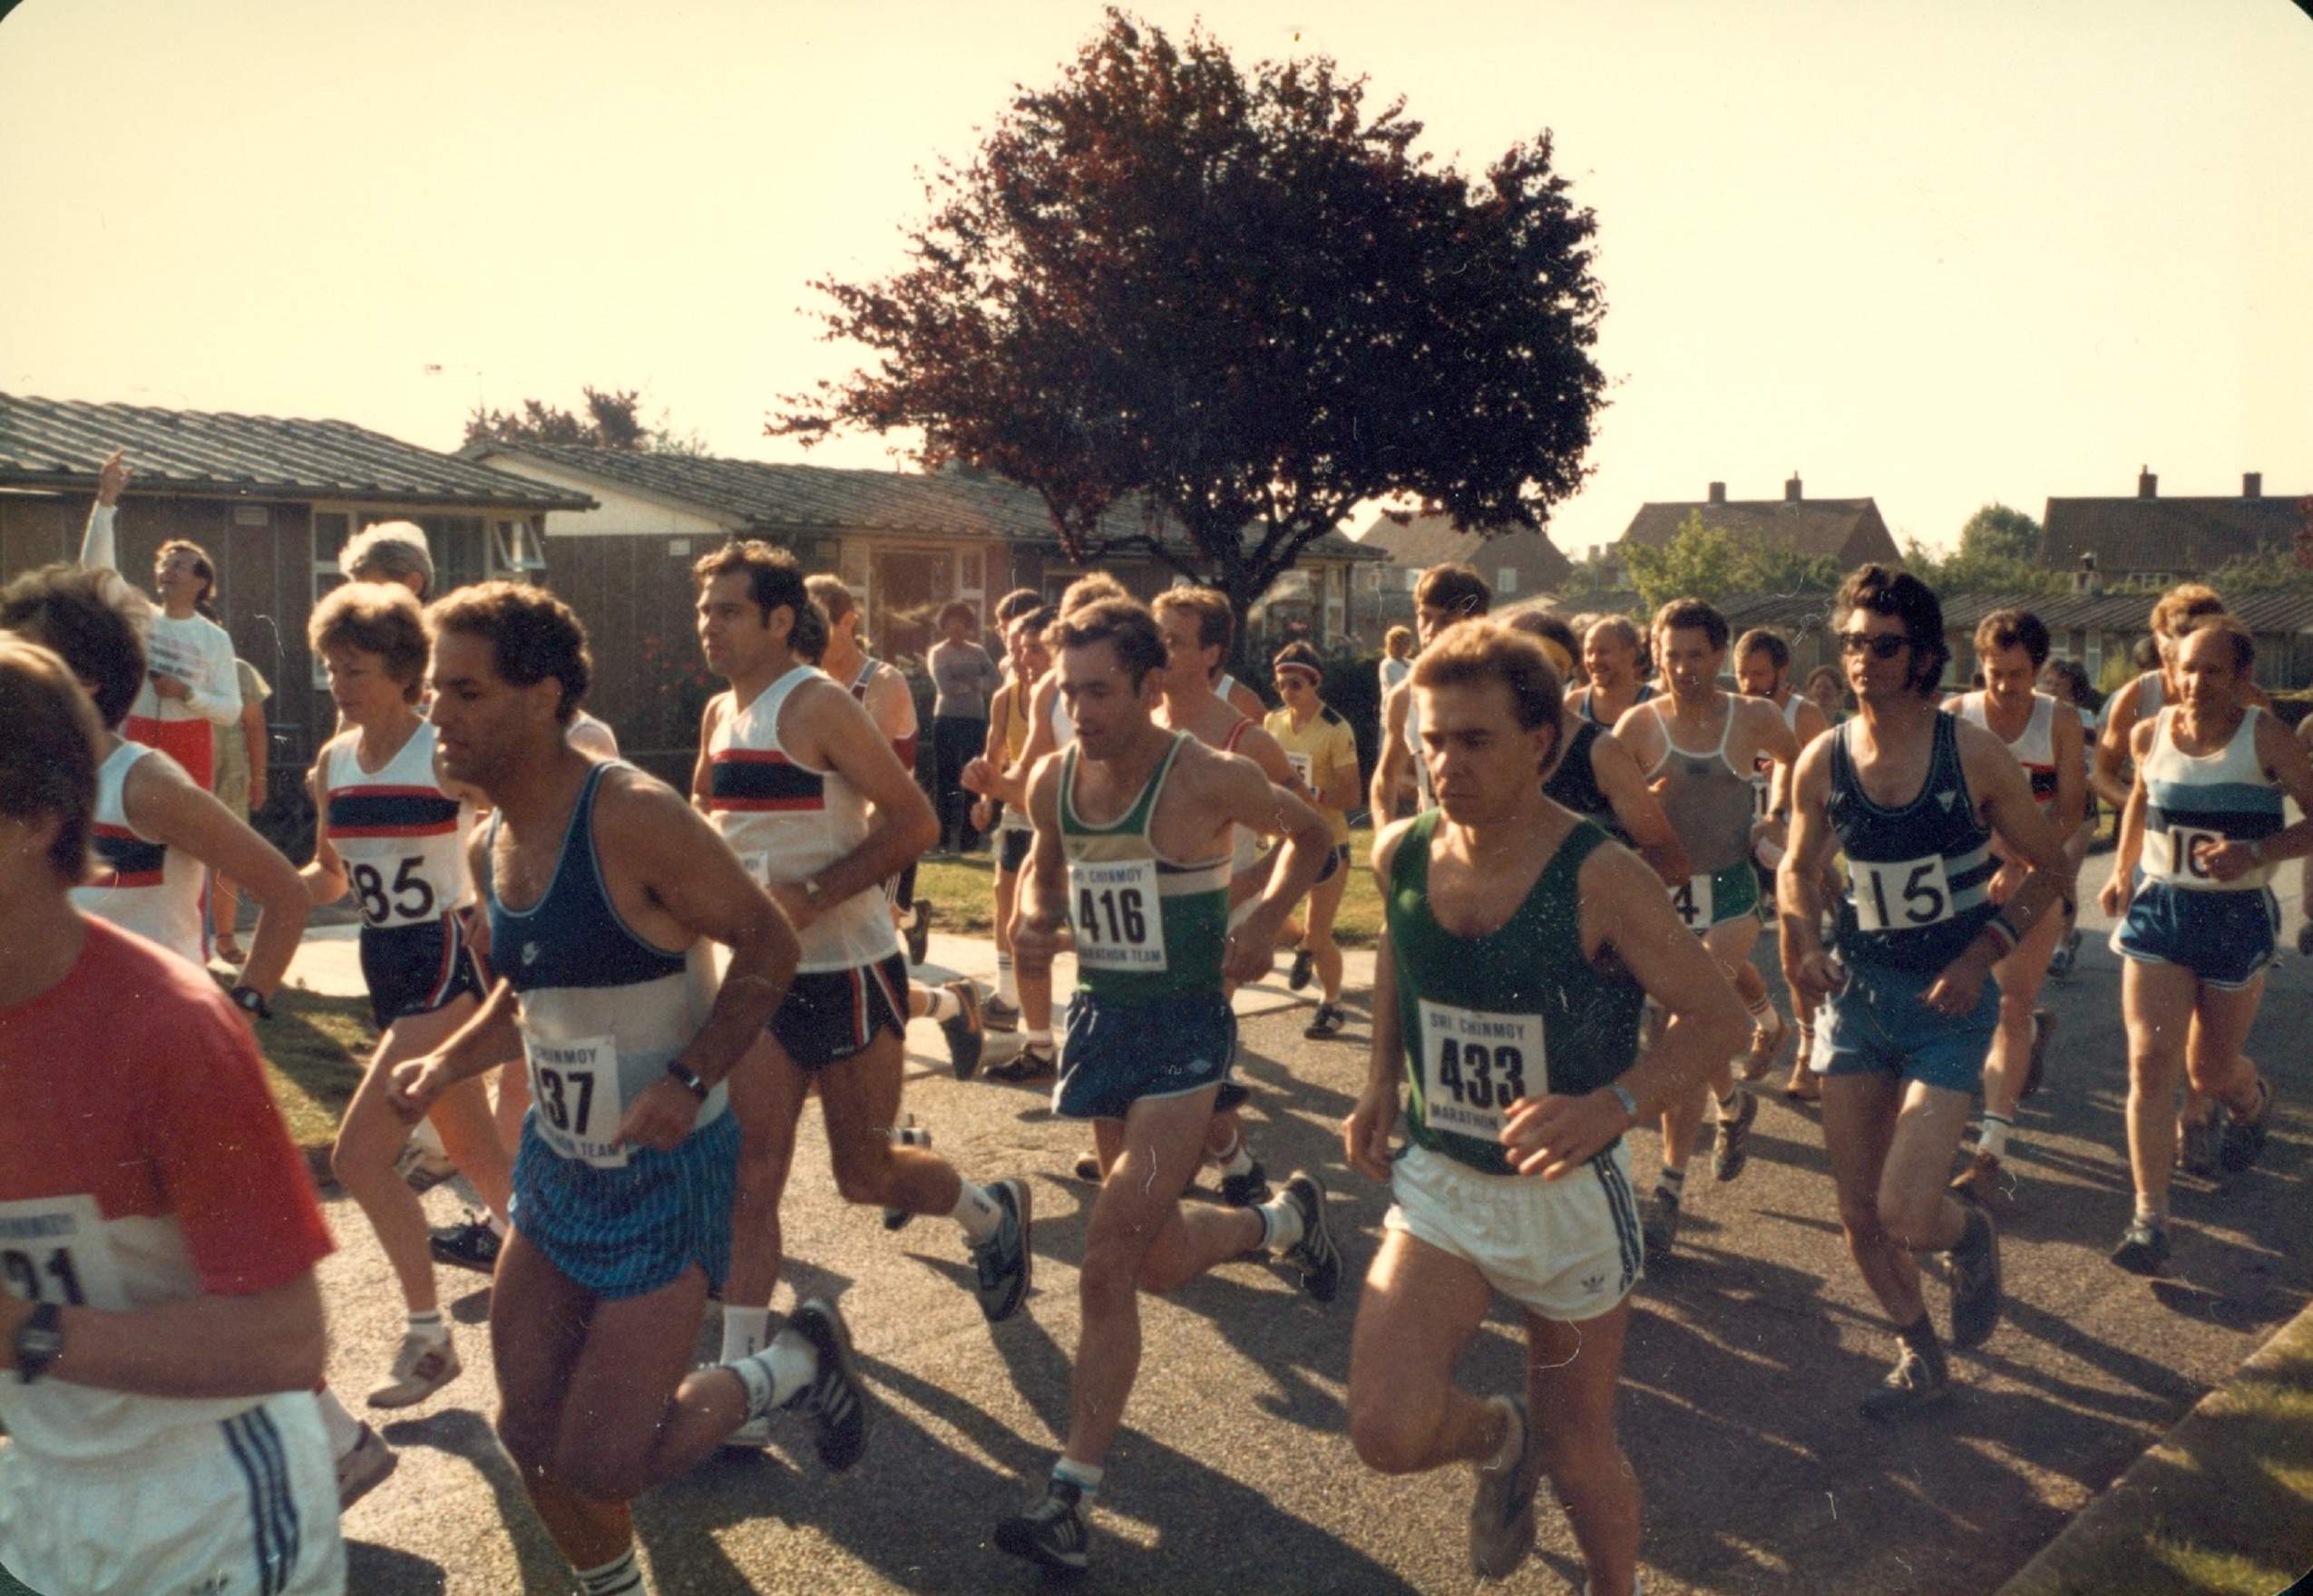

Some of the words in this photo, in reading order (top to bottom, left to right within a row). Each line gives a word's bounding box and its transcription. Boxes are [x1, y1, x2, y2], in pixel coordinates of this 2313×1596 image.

[344, 855, 434, 923] 85
[1079, 888, 1146, 944] 416
[1673, 879, 1700, 924] 4
[1870, 863, 1944, 926] 15
[1430, 1012, 1451, 1029] SRI
[1459, 1018, 1525, 1039] CHINMOY
[1440, 1037, 1526, 1109] 433
